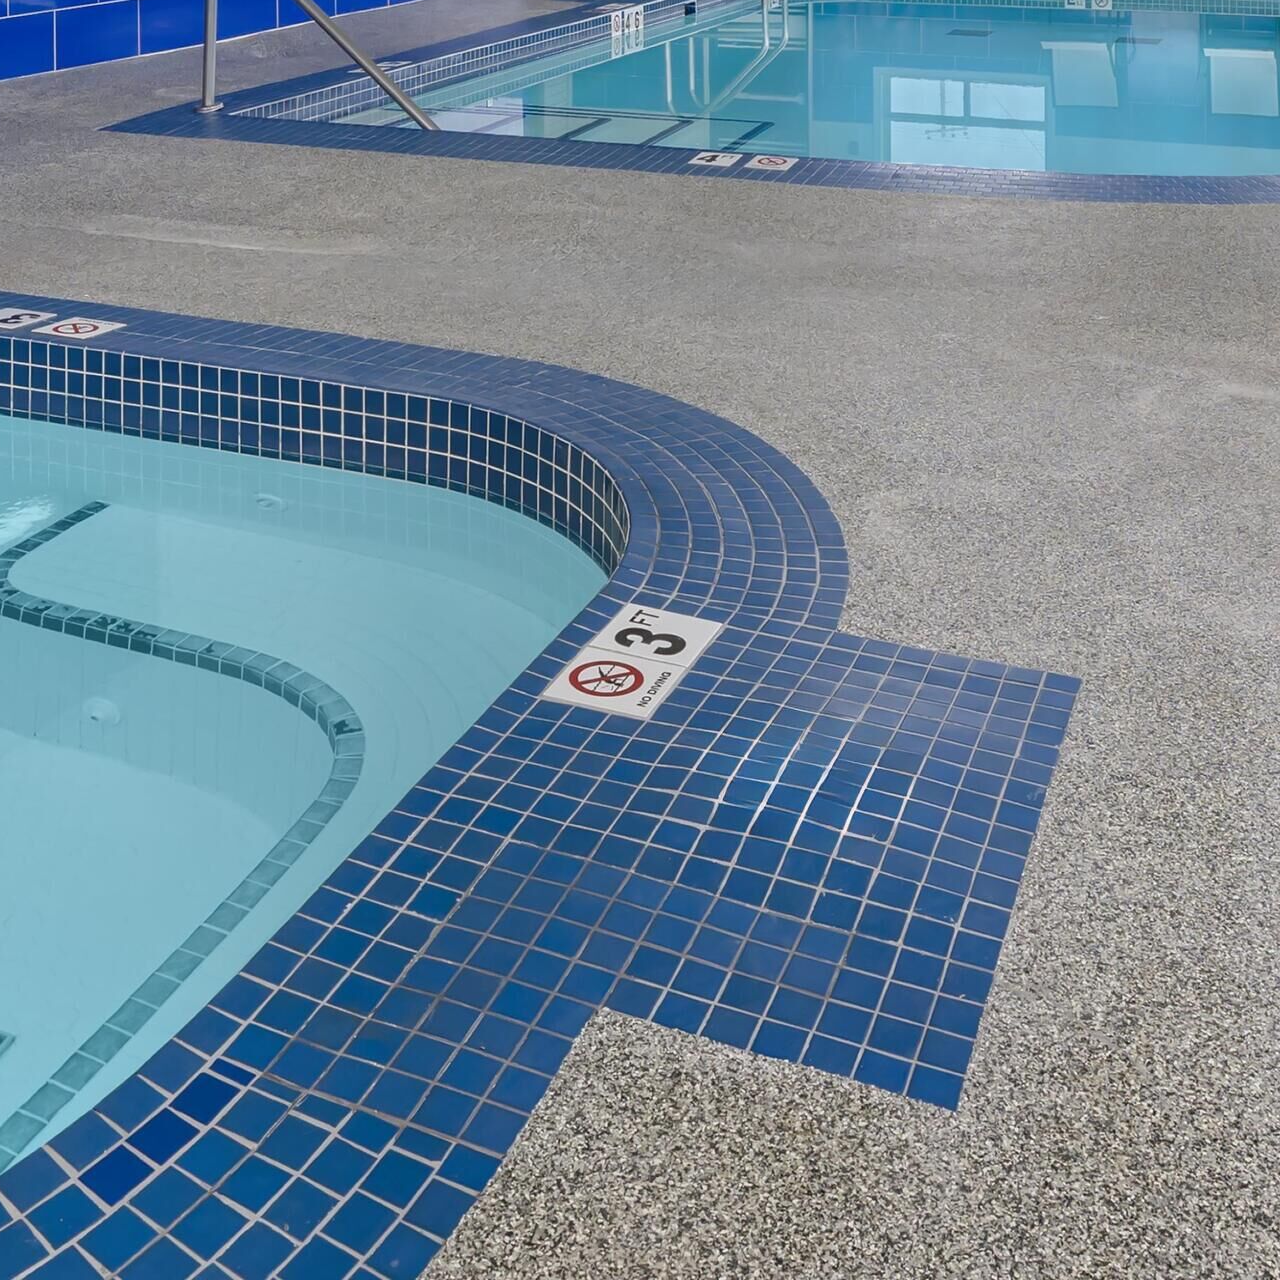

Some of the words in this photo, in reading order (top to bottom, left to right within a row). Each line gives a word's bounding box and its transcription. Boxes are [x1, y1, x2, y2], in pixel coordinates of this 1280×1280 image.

[696, 154, 721, 163] 4
[629, 609, 660, 627] FT
[614, 627, 687, 656] 3
[636, 695, 652, 708] NO
[646, 671, 672, 695] DIVING
